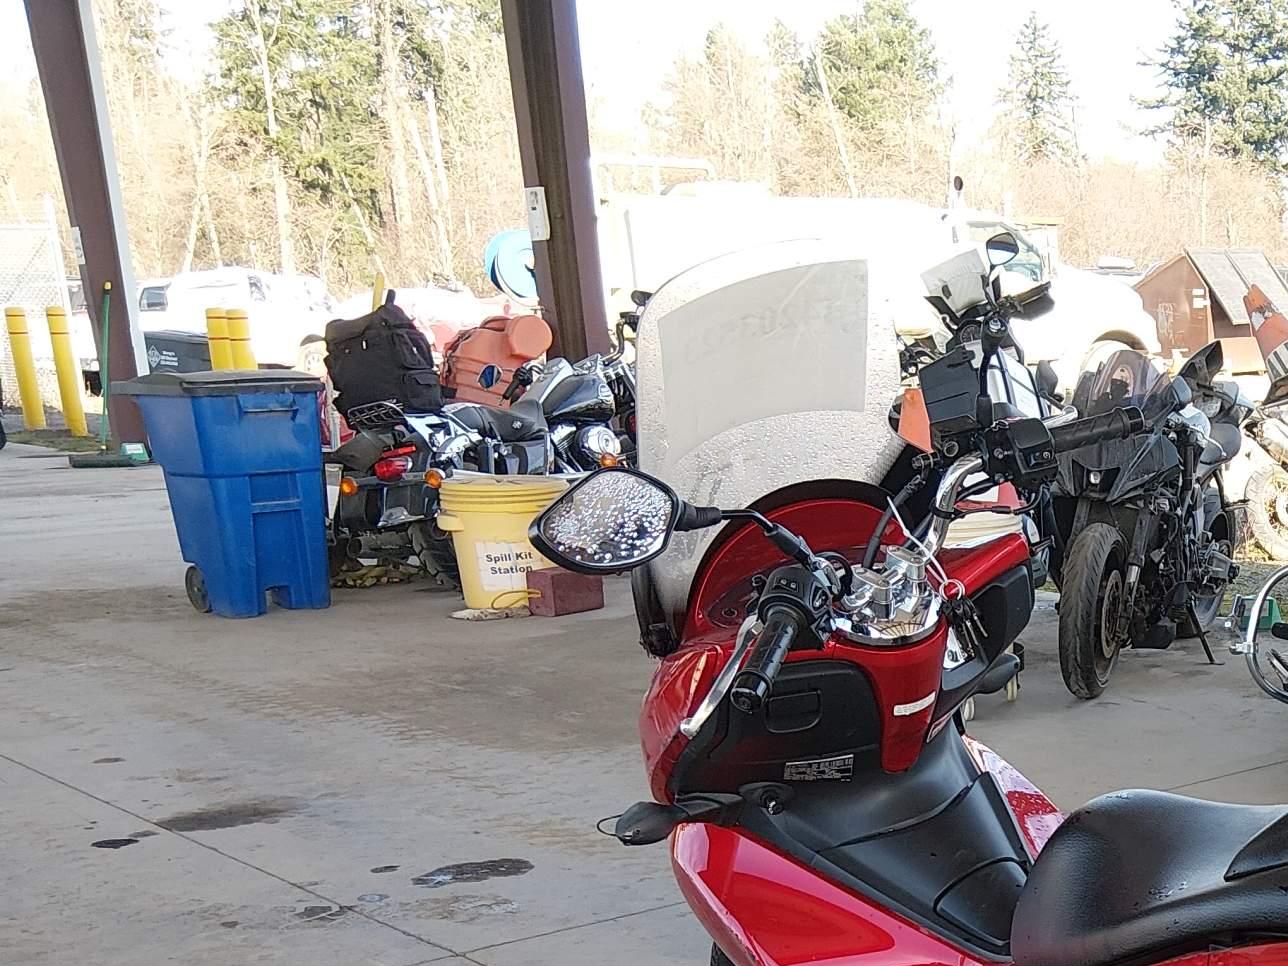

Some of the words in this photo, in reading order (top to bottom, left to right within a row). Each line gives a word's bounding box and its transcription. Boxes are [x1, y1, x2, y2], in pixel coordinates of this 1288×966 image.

[486, 553, 511, 564] Spill
[516, 551, 533, 560] Kit
[490, 565, 533, 575] Station
